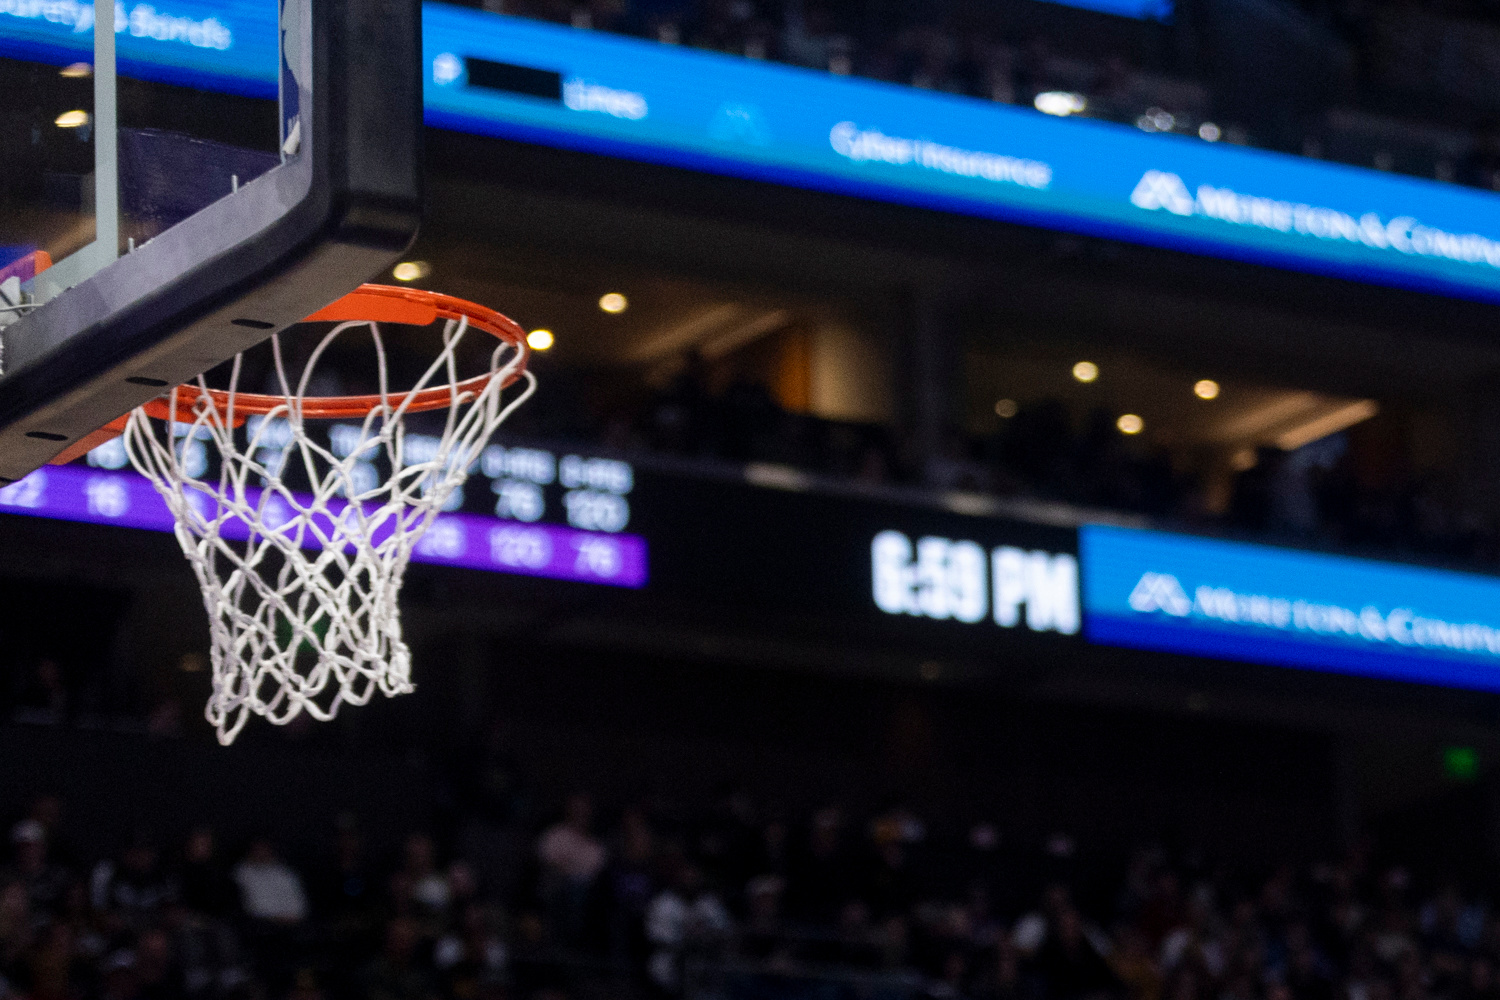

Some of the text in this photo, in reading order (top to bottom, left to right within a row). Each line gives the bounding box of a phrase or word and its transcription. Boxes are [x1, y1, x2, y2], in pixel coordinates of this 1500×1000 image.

[829, 120, 1052, 190] Cyber Insurance
[991, 545, 1082, 636] PM
